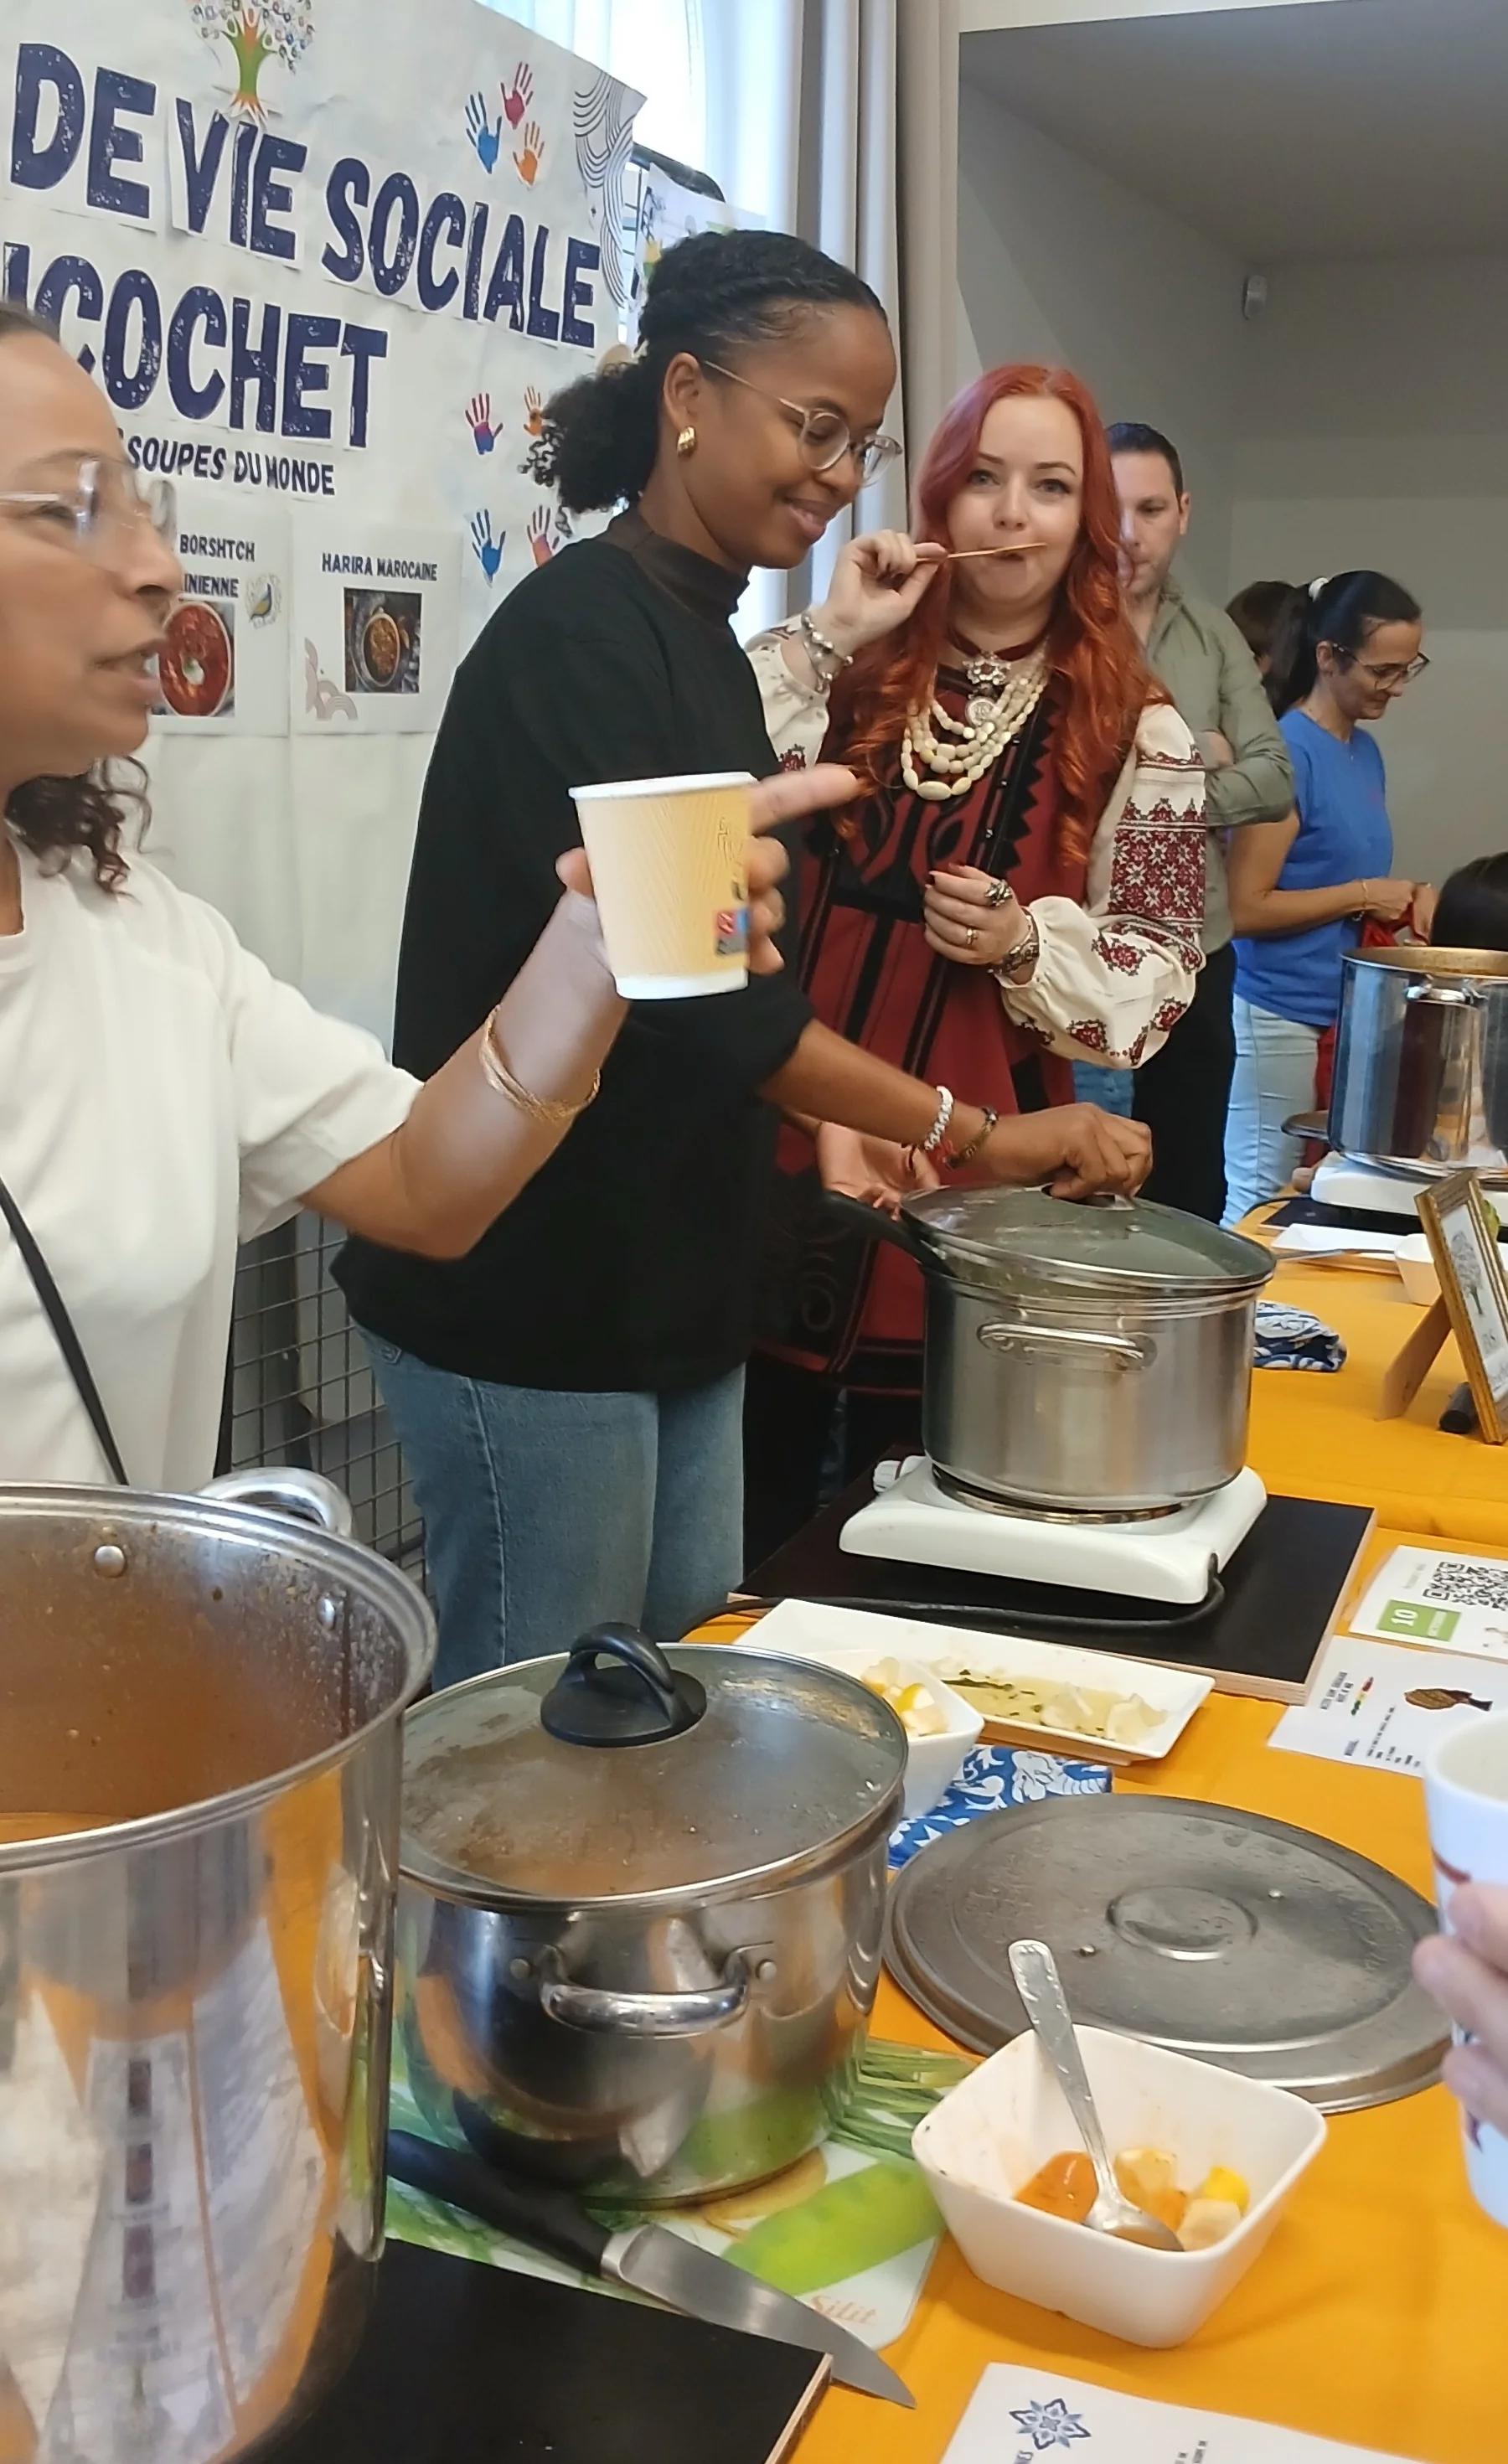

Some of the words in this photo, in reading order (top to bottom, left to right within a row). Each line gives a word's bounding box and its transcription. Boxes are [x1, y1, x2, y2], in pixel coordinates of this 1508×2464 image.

[11, 43, 157, 219] DE
[175, 97, 307, 260] VIE
[321, 158, 601, 349] SOCIALE
[127, 435, 227, 481] SOUPES
[233, 450, 261, 485] DU
[264, 454, 334, 496] MONDE
[179, 534, 256, 562] BORSHTCH
[322, 553, 374, 576] HARIRA
[376, 557, 437, 581] MAROCAINE
